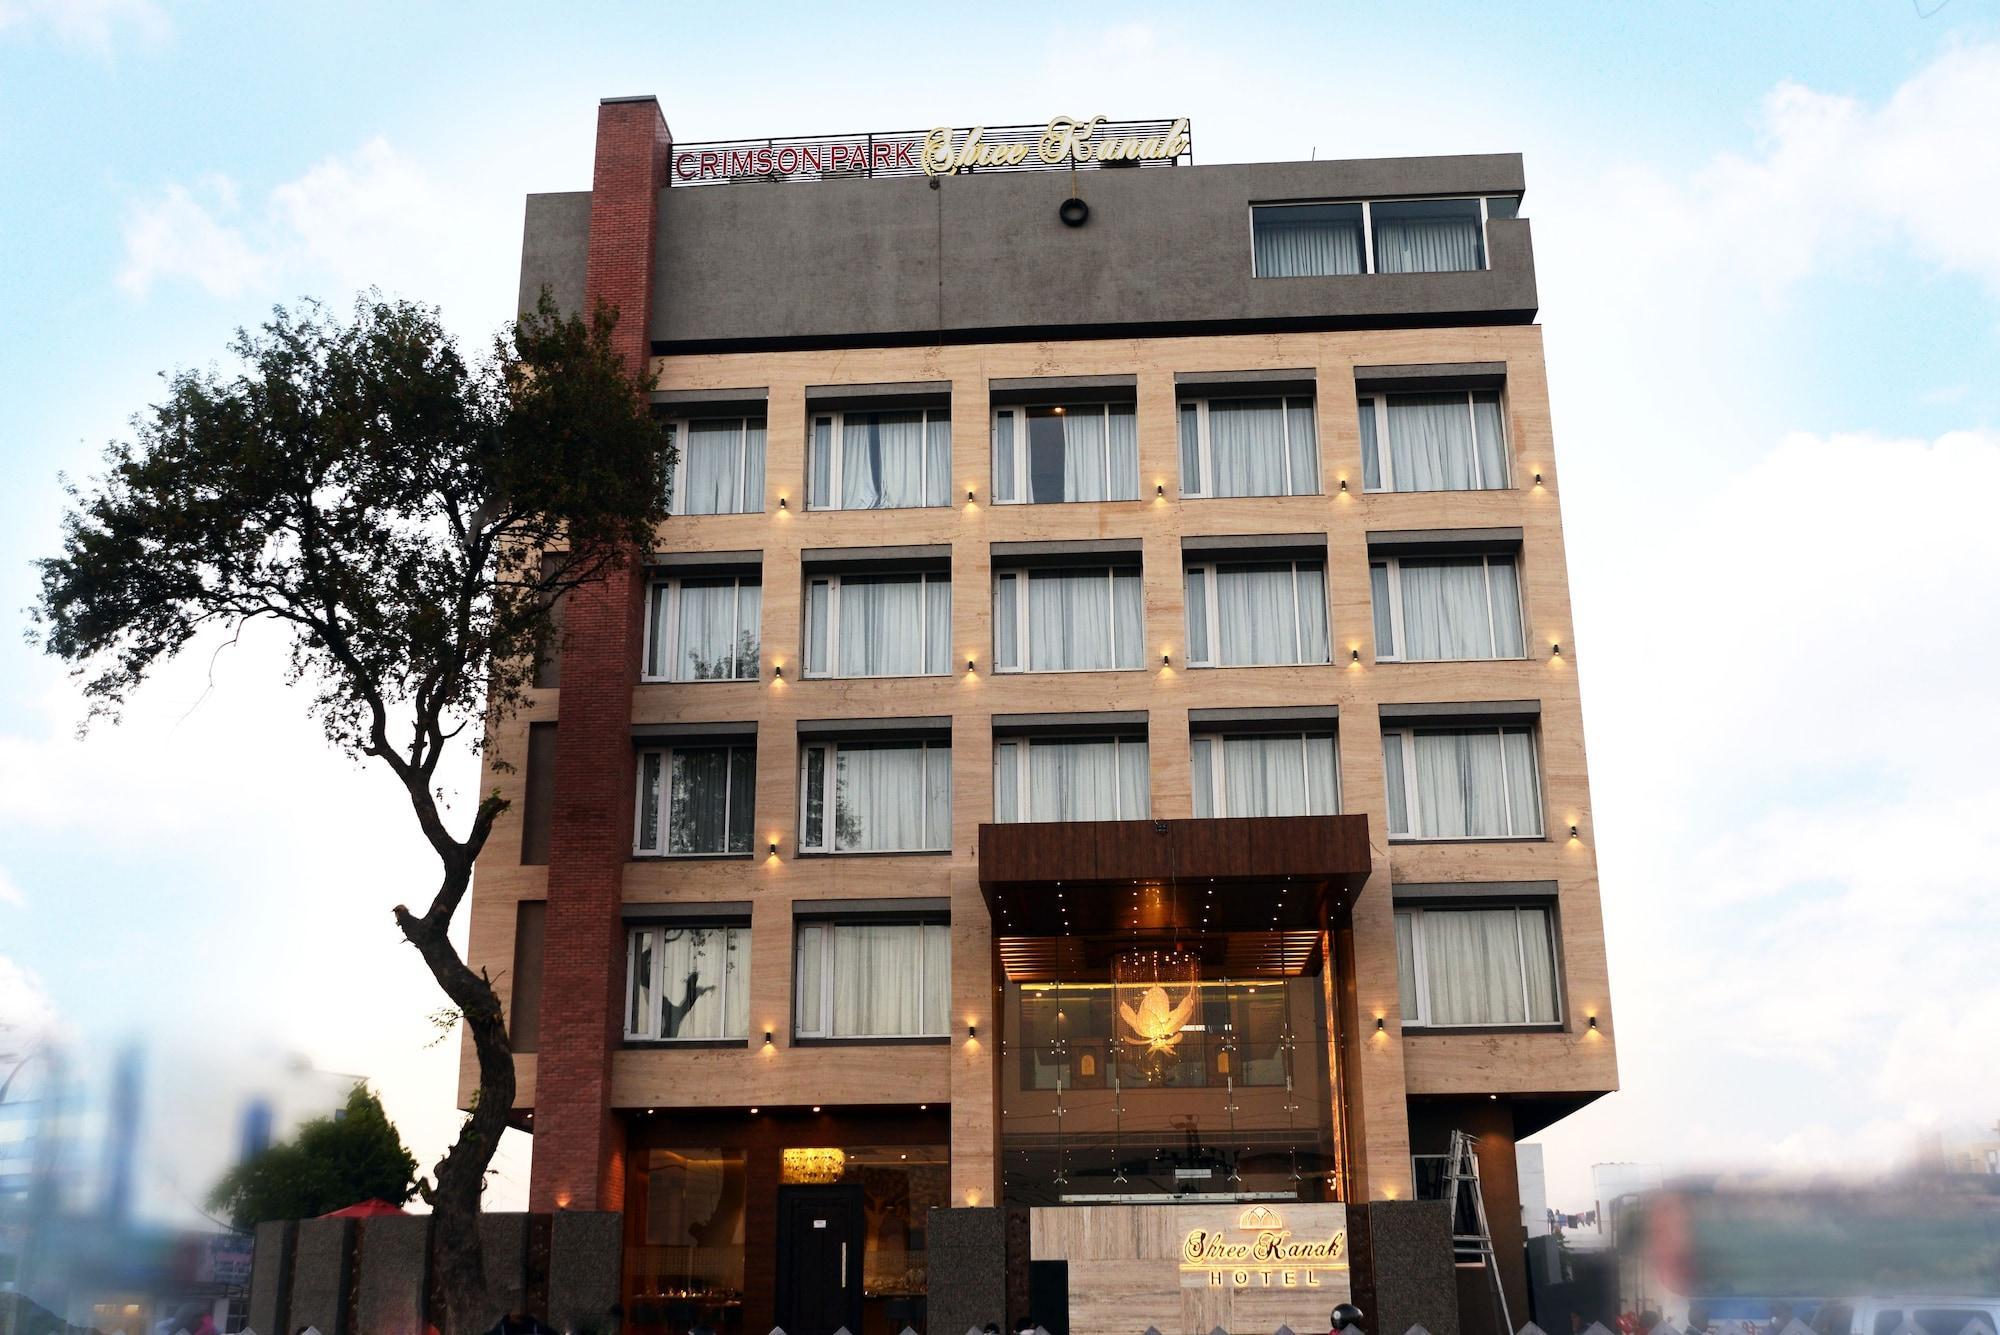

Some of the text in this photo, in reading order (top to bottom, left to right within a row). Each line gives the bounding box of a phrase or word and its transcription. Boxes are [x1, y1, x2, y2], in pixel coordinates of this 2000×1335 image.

[675, 140, 916, 180] CRIMSON PARK
[921, 115, 1189, 176] Shree Kanak
[1184, 1230, 1344, 1263] Shree Kanak
[1210, 1269, 1320, 1286] HOTEL
